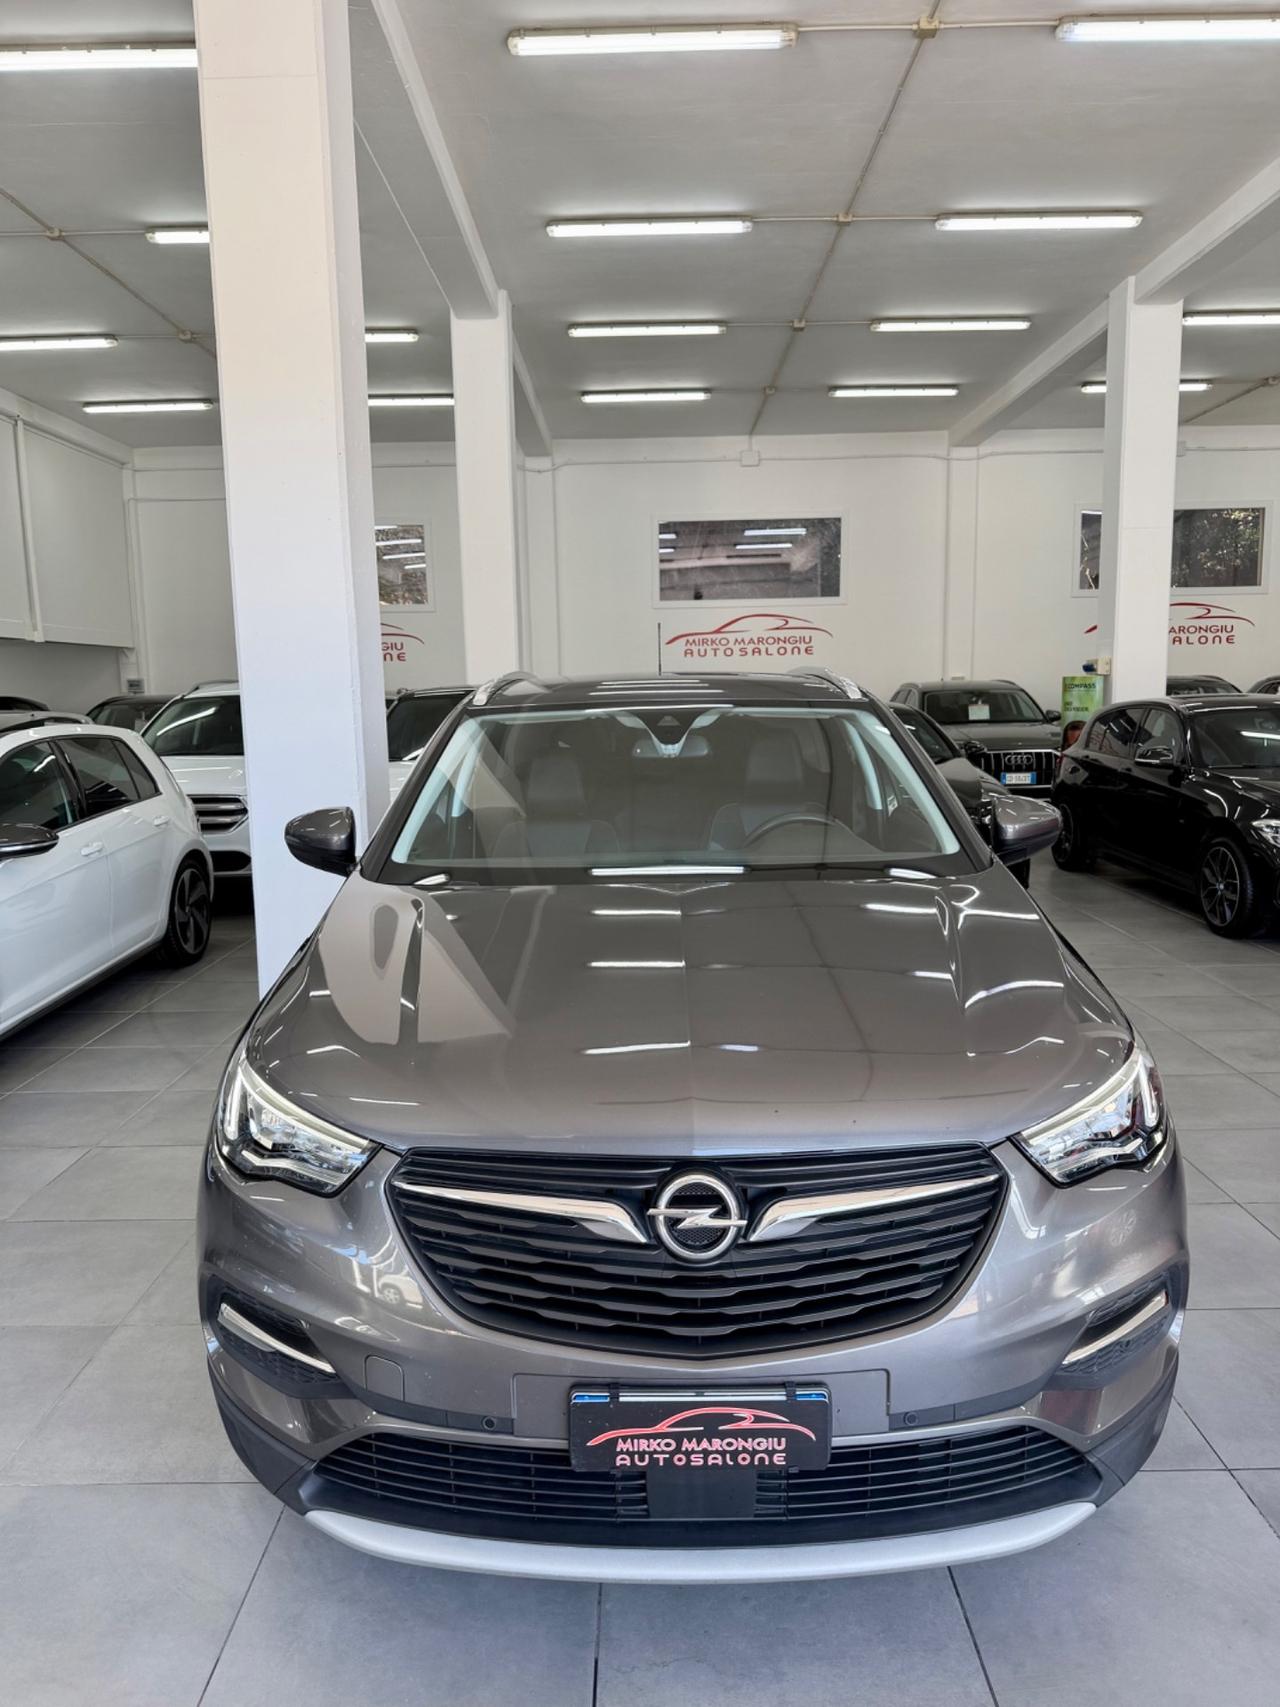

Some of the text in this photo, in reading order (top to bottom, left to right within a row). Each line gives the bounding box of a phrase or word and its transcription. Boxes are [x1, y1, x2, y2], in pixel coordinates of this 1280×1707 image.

[1168, 624, 1235, 635] ARONGIU
[684, 635, 813, 647] MIRKO MARONGIU
[1172, 634, 1236, 646] ALONE
[683, 645, 814, 658] AUTOSALONE
[616, 1436, 787, 1452] MIRKO MARONGIU
[615, 1452, 787, 1467] AUTOSALONE
